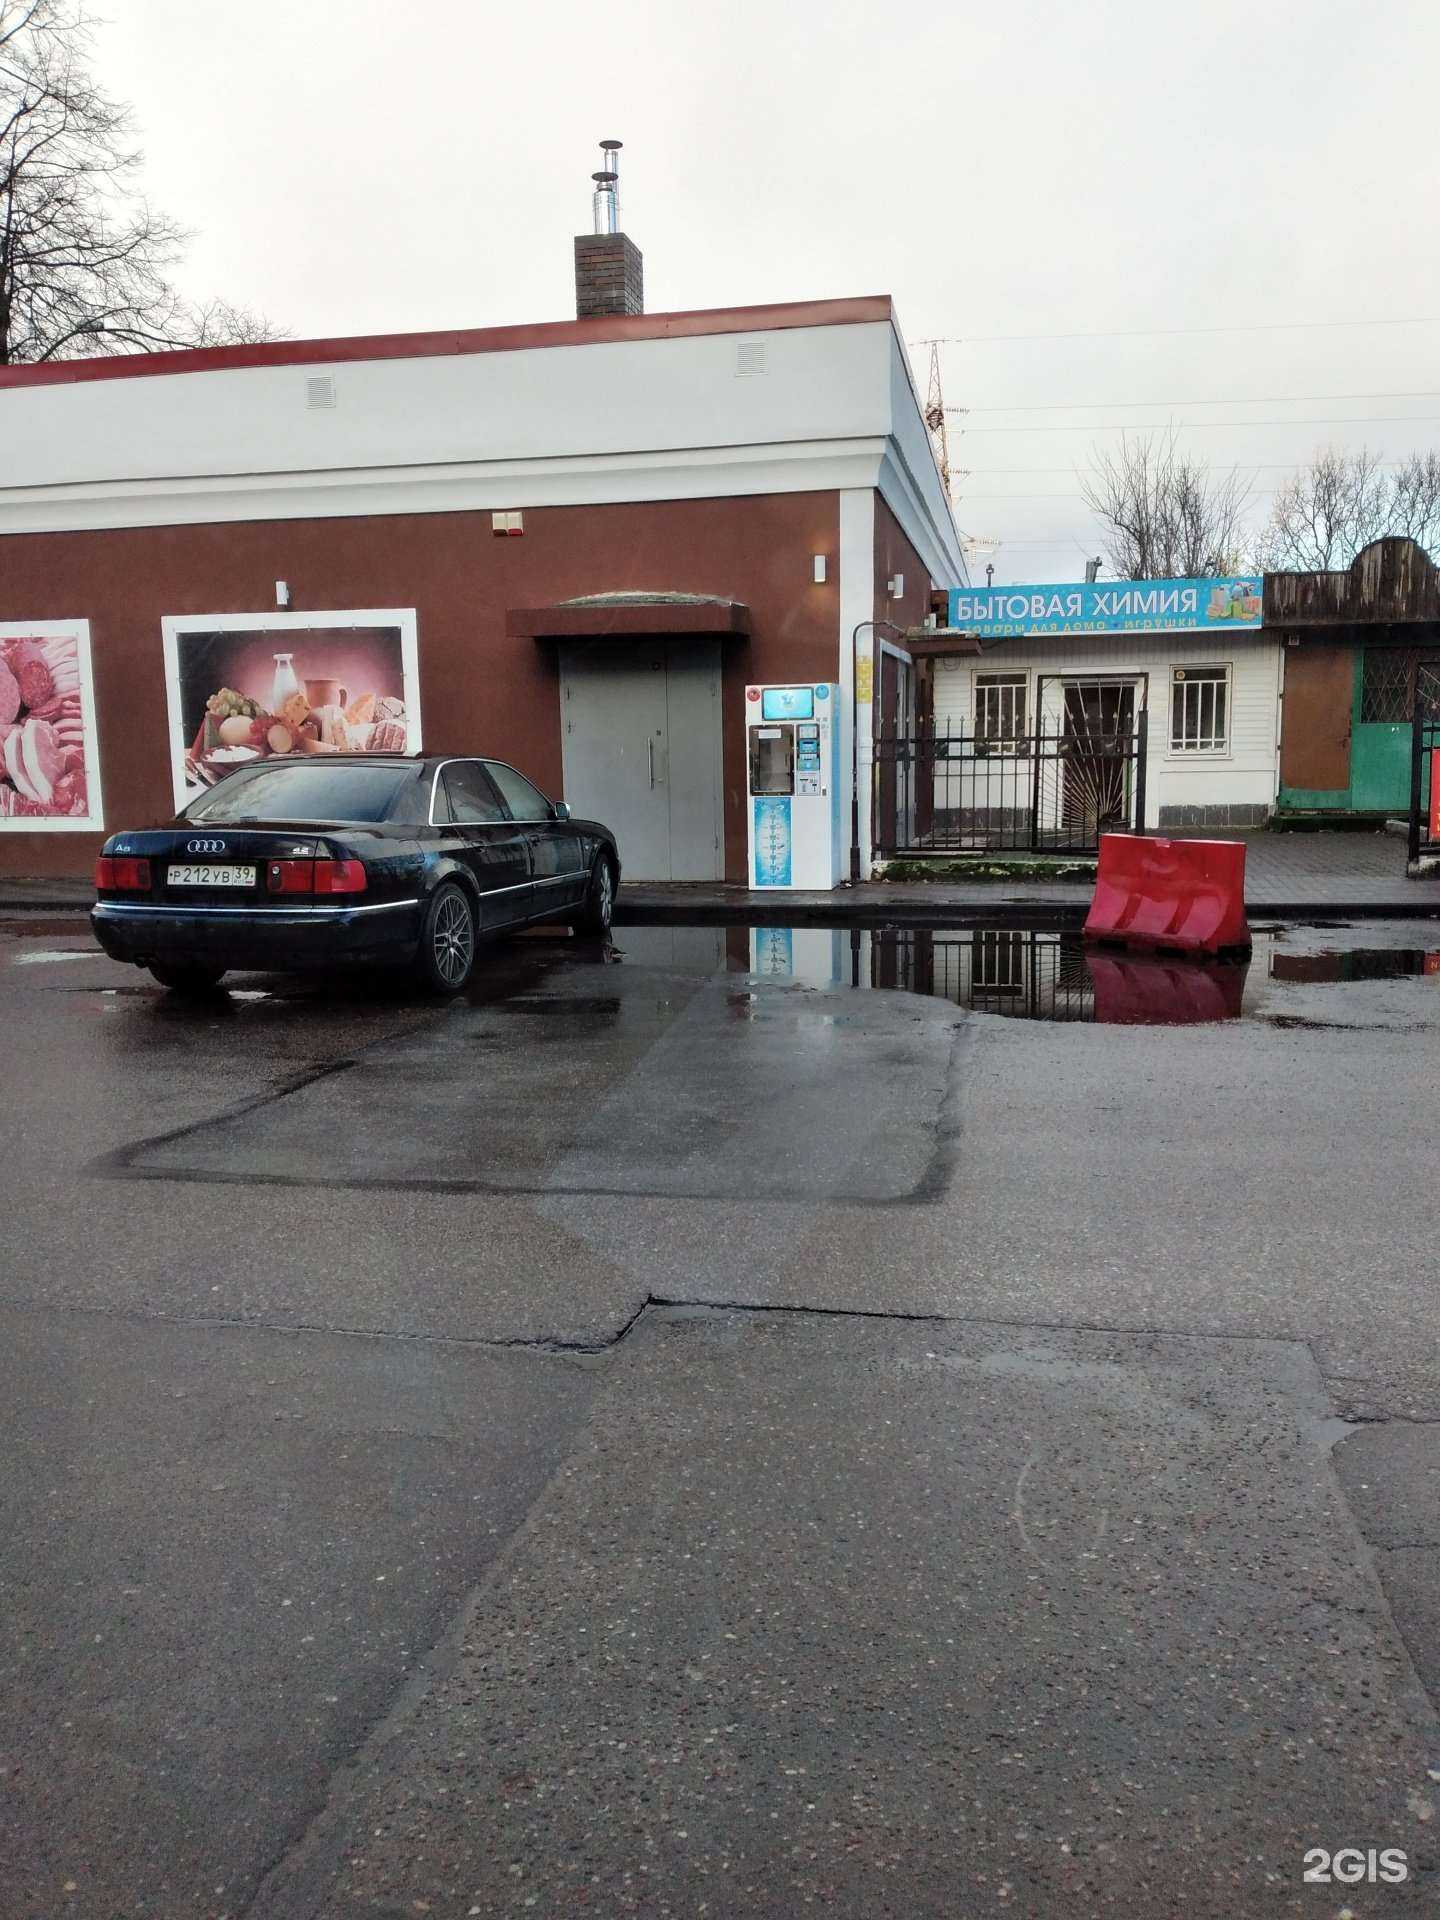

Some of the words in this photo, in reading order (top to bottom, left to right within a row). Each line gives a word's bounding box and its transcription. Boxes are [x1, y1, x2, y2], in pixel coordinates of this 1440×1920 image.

[957, 594, 1082, 620] БЫТОВАЯ
[1092, 588, 1198, 616] ХИМИЯ
[1031, 622, 1057, 632] для
[1064, 620, 1105, 632] дома
[1124, 616, 1198, 630] игрушки
[235, 866, 251, 880] 39
